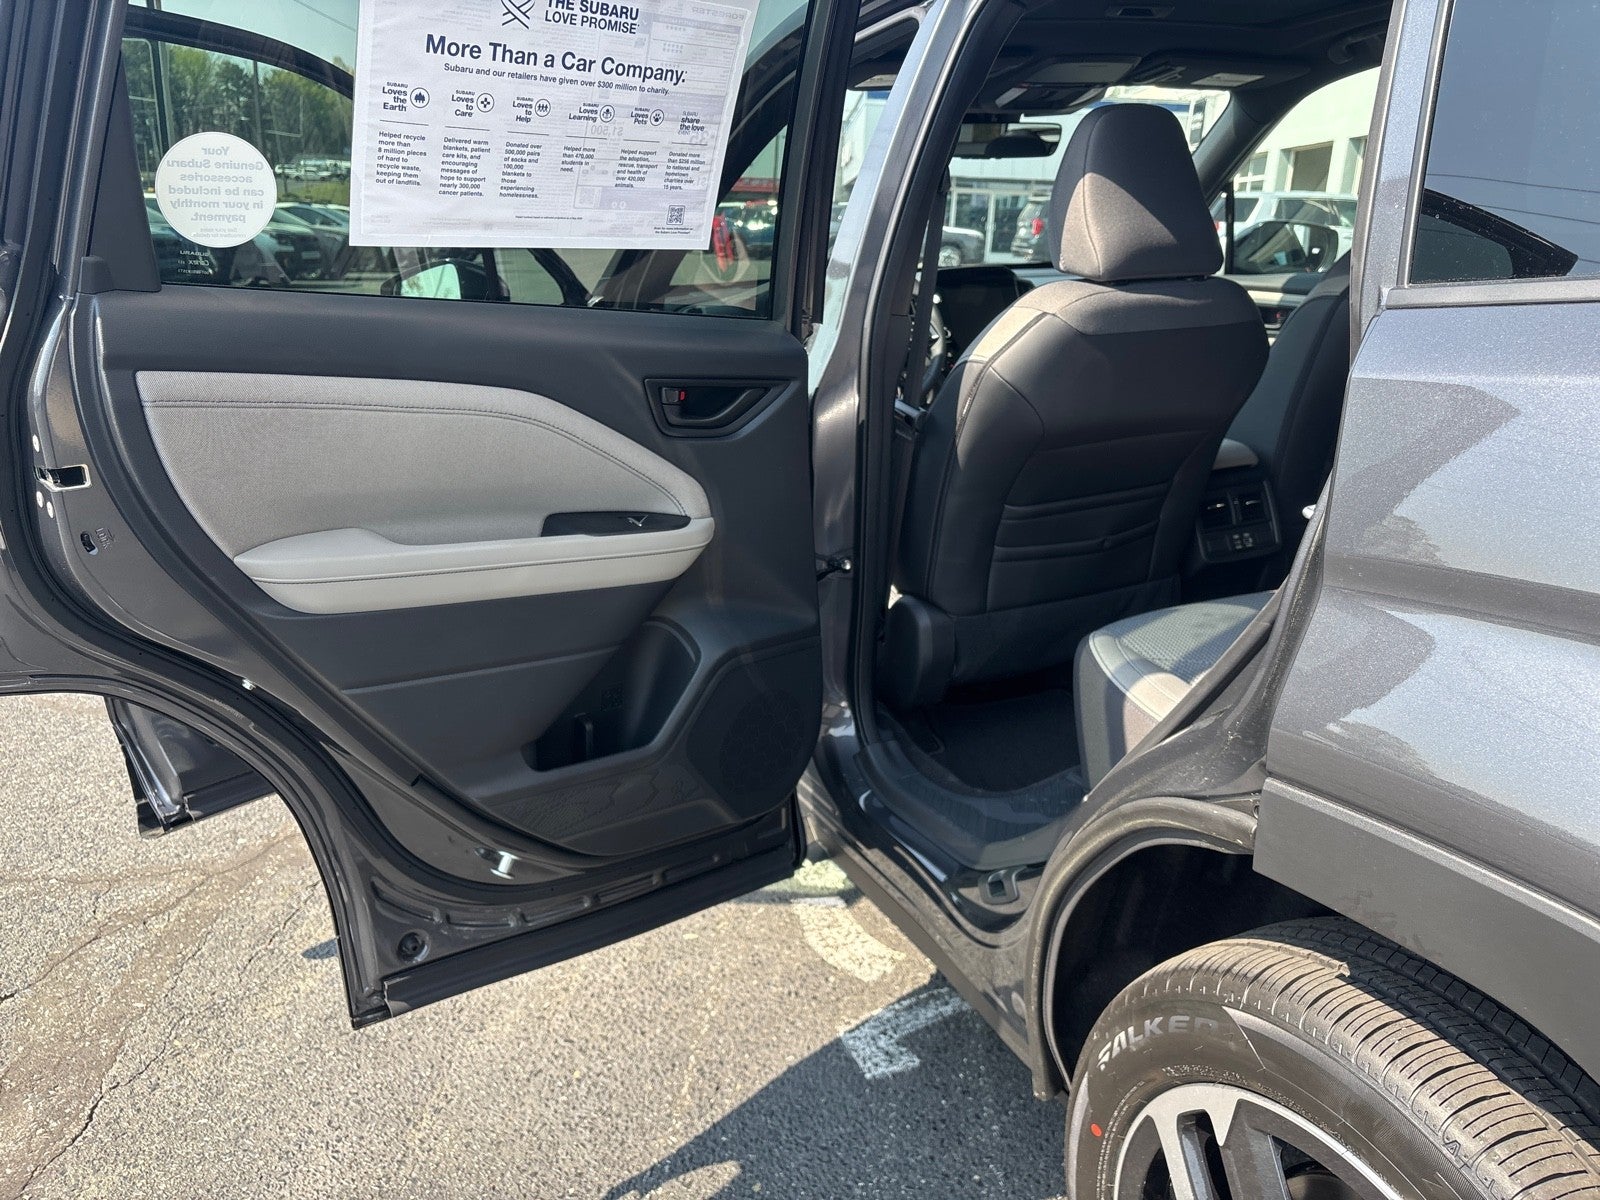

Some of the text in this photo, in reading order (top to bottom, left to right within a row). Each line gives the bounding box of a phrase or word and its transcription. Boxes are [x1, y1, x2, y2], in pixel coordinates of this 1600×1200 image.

[548, 0, 639, 20] THE SUBARU
[545, 10, 577, 25] LOVE
[581, 15, 637, 34] PROMISE
[426, 34, 482, 59] More
[489, 42, 538, 66] Than
[544, 54, 555, 68] a
[561, 52, 596, 73] Car
[444, 63, 473, 74] Subaru
[508, 71, 537, 80] retailers
[540, 74, 556, 82] have
[558, 78, 578, 88] given
[597, 80, 613, 89] $300
[615, 83, 637, 92] million
[647, 86, 669, 95] charity.
[382, 87, 407, 96] Loves
[393, 96, 407, 104] the
[452, 95, 474, 103] Loves
[383, 103, 406, 112] Earth
[455, 109, 473, 117] Care
[569, 113, 597, 122] Learning
[516, 115, 531, 123] Help
[379, 131, 401, 139] Helped
[377, 163, 399, 171] recycle
[376, 170, 401, 178] keeping
[1097, 1016, 1219, 1072] FALKEN
